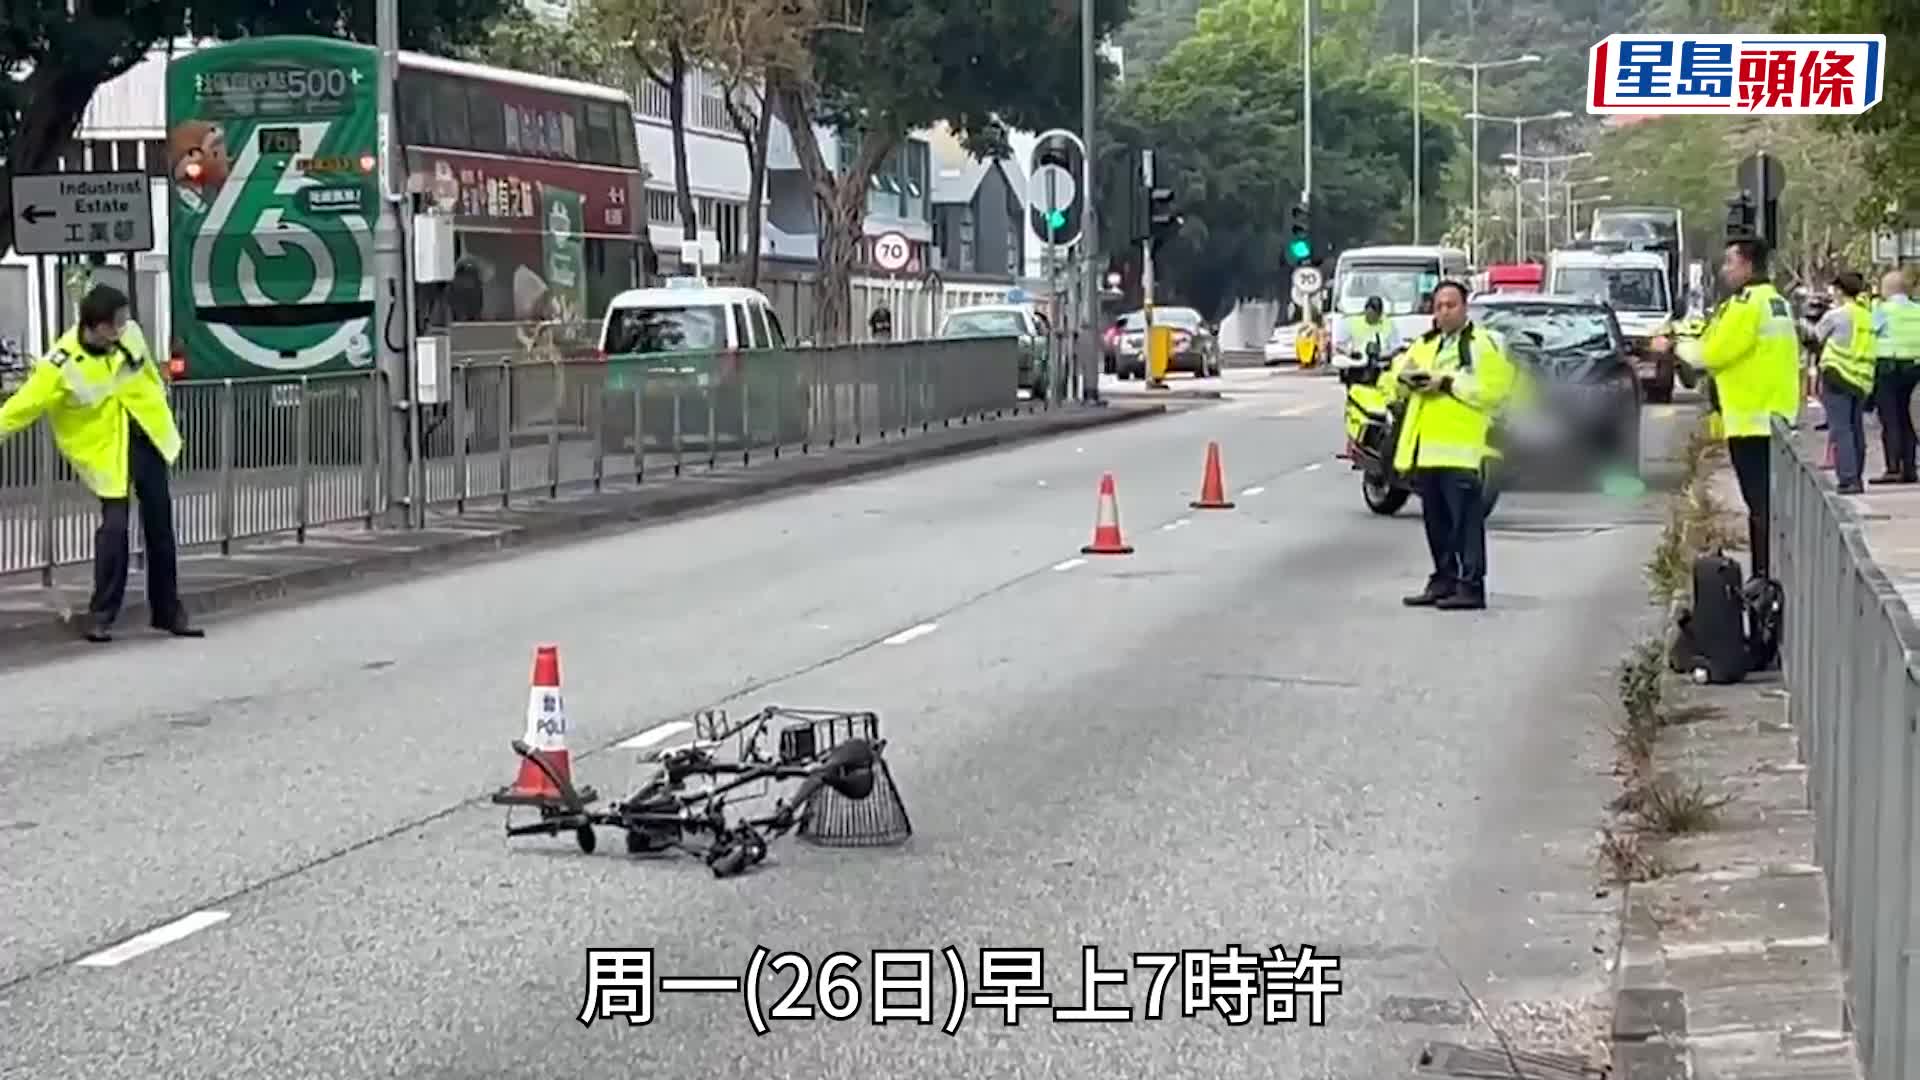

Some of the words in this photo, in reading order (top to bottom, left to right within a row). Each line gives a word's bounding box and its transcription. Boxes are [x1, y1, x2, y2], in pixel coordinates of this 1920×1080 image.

[60, 180, 142, 195] Industrial
[75, 199, 128, 214] Estate
[881, 243, 903, 259] 70
